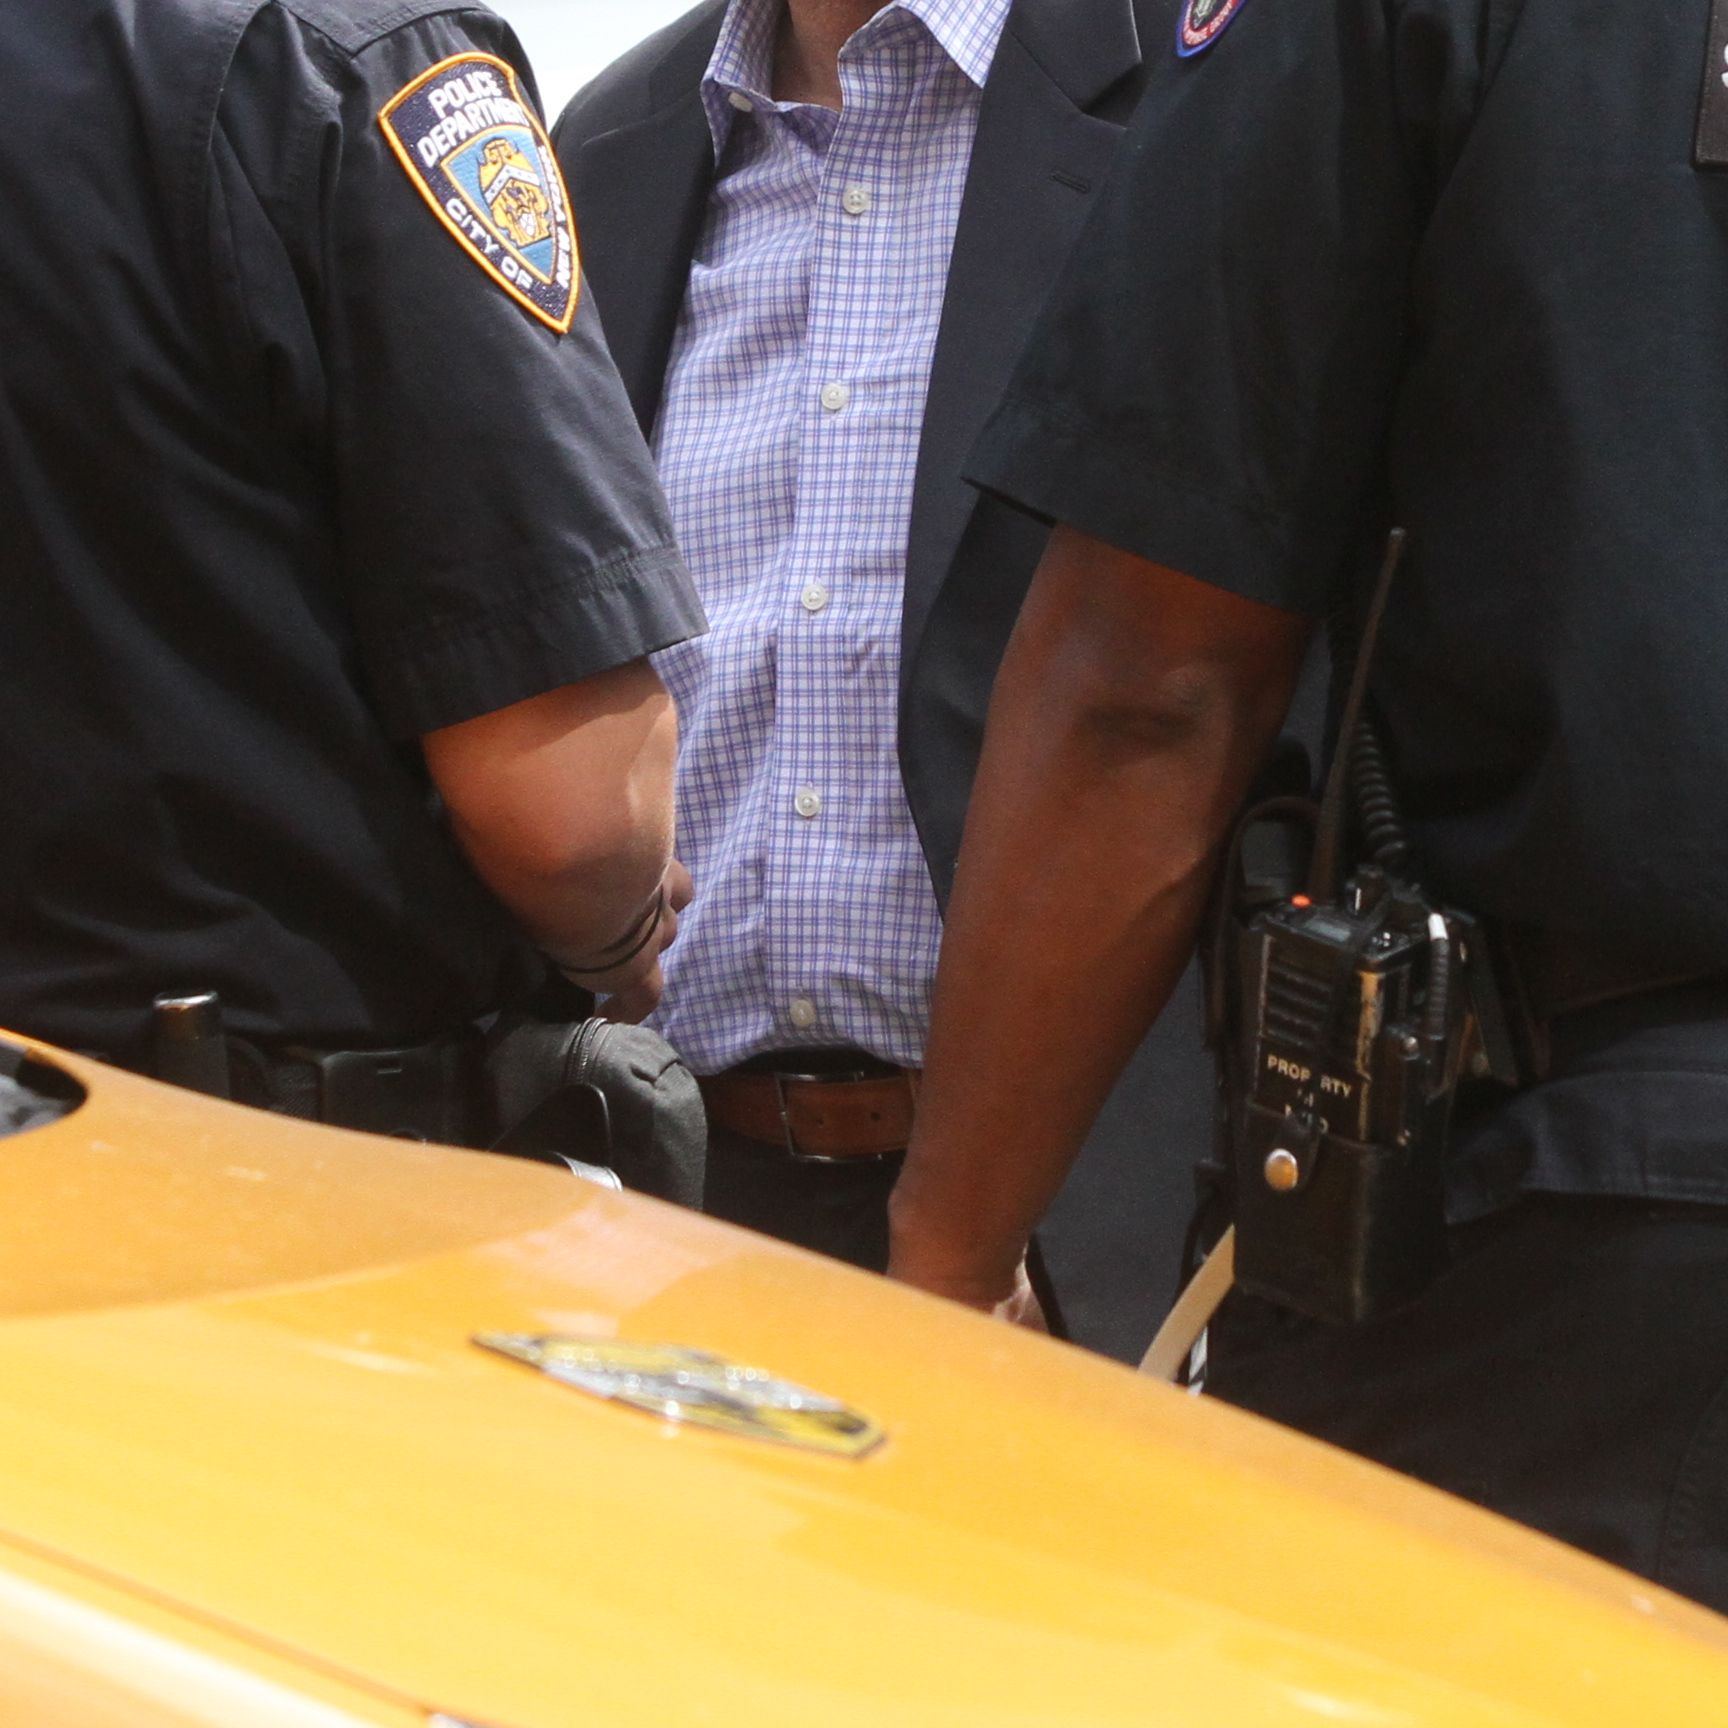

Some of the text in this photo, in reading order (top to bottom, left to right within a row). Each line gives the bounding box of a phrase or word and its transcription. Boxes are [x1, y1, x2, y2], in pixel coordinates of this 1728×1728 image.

[428, 71, 502, 119] POLICE
[446, 198, 499, 253] CITY
[501, 255, 533, 289] OF
[1267, 1054, 1352, 1098] PROPRTY
